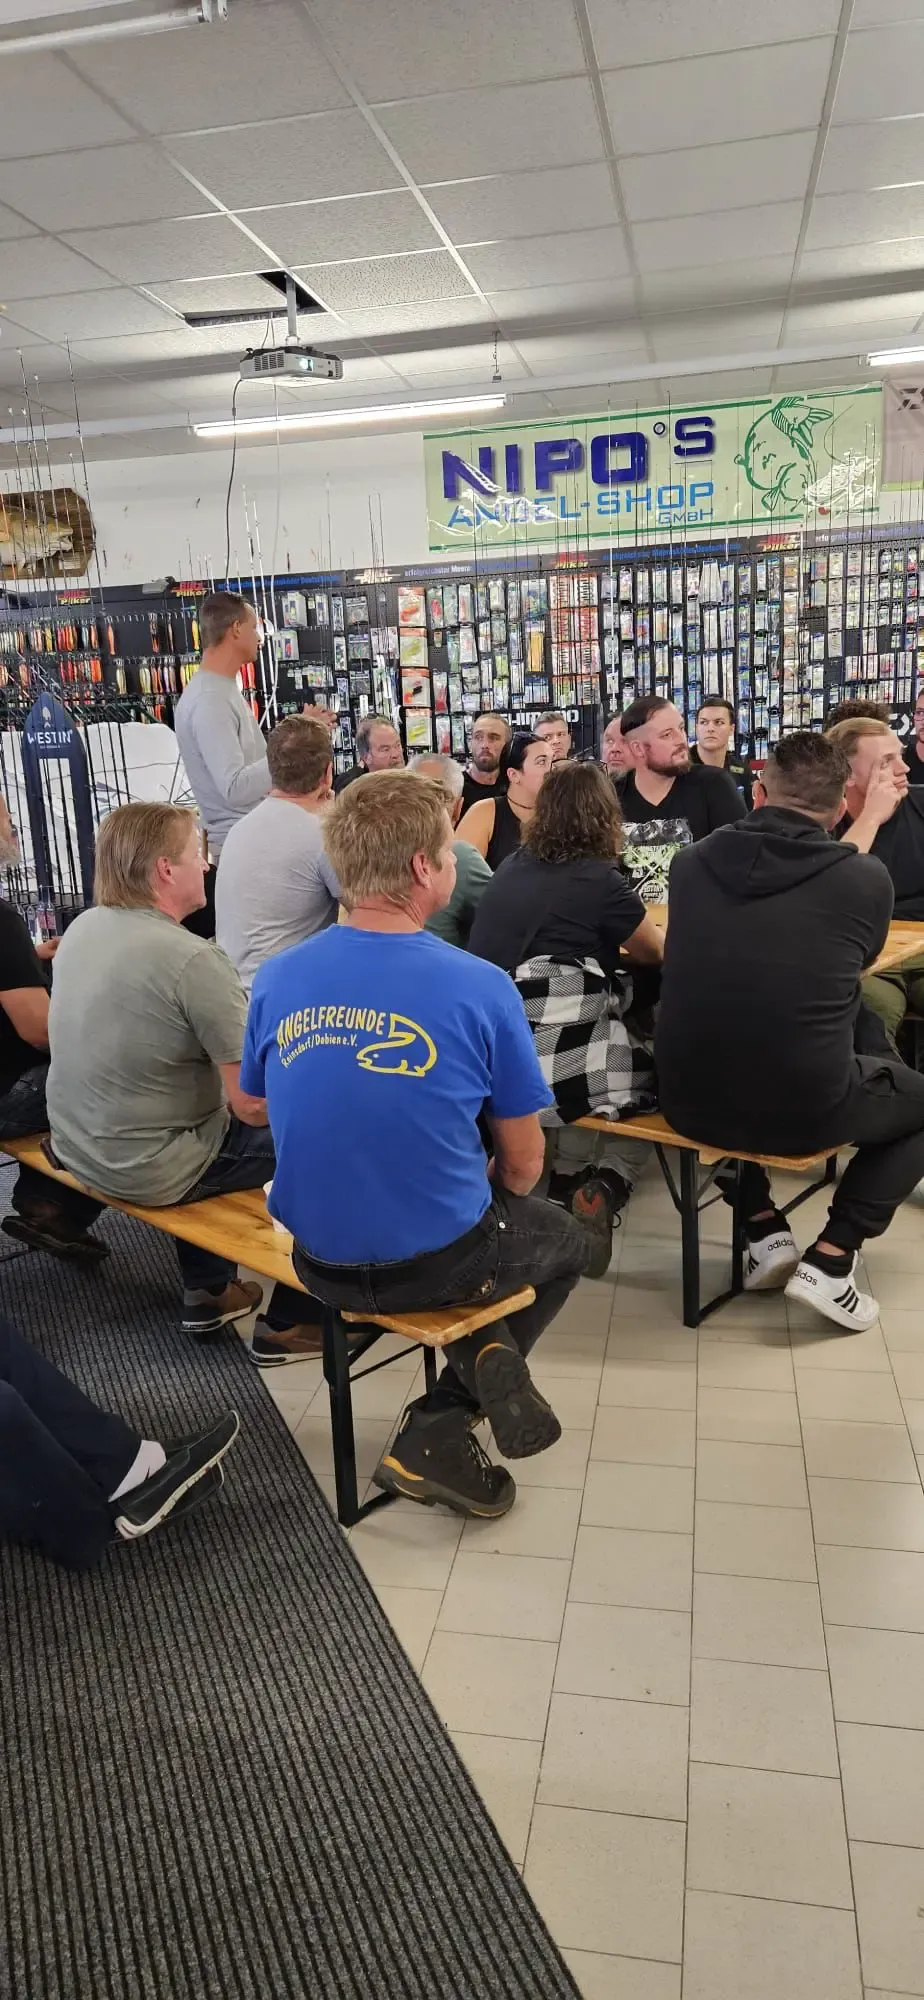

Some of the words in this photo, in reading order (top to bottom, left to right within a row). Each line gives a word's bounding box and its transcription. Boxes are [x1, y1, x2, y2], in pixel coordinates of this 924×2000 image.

[27, 730, 71, 744] WESTIN
[277, 1006, 386, 1057] ANGELFREUNDE
[768, 1238, 793, 1251] adida
